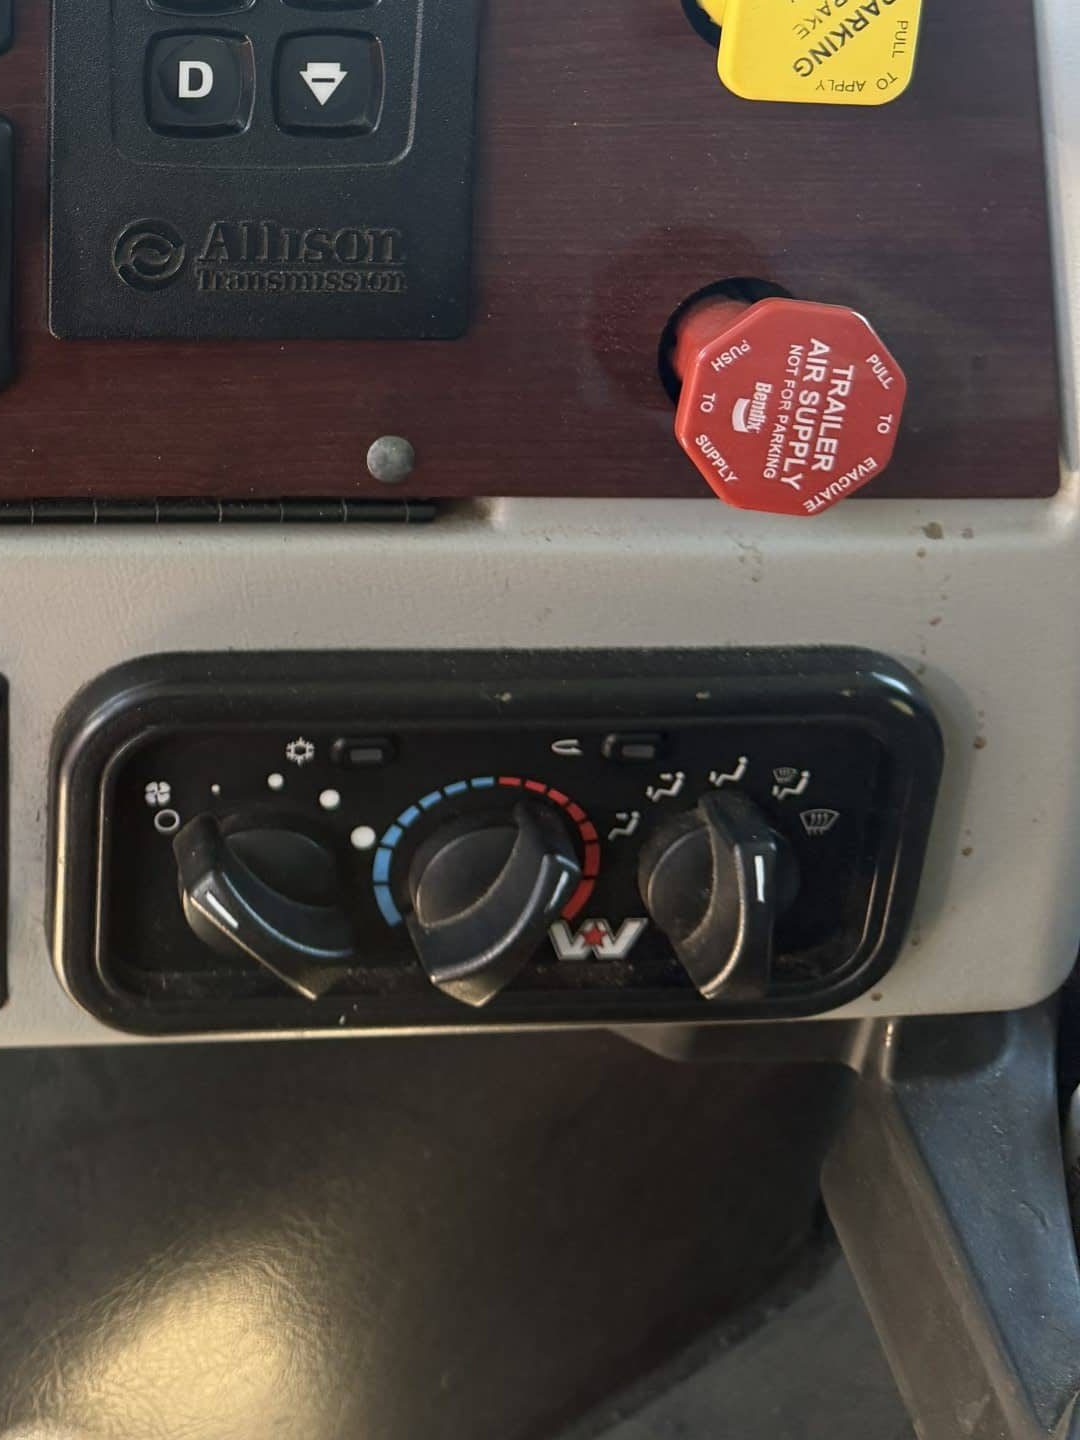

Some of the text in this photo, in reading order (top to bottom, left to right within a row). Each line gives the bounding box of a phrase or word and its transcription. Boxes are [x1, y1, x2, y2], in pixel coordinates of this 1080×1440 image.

[179, 61, 213, 98] D
[815, 20, 908, 92] PULL TO APPLY
[197, 220, 406, 264] Allison
[695, 339, 751, 483] PUSH TO SUPPLY
[747, 382, 772, 433] Bendix
[763, 344, 804, 479] NOT FOR PARKING
[781, 338, 830, 491] AIR SUPPLY
[802, 354, 895, 513] PULL TO EVACUATE
[811, 365, 855, 471] TRAILER
